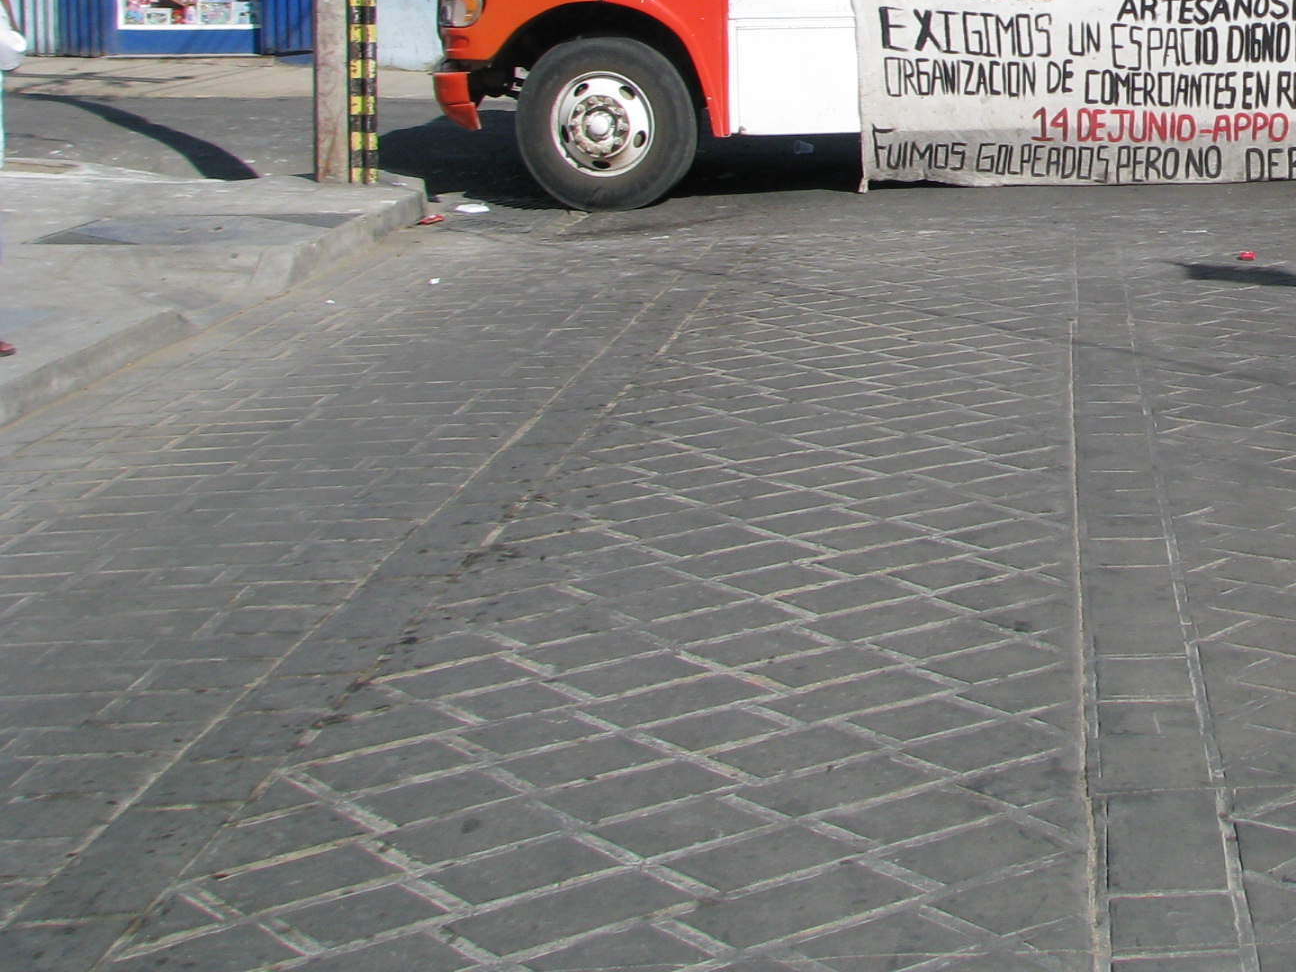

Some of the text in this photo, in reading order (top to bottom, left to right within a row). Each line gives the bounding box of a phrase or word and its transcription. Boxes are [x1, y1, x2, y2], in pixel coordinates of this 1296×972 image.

[879, 6, 1053, 58] EXIGIMOS
[1068, 21, 1100, 56] UN
[1111, 23, 1219, 71] ESPACIO
[1226, 21, 1290, 63] DIGNO
[884, 57, 1036, 98] ORGANIZACION
[1046, 59, 1074, 94] DE
[1085, 69, 1237, 110] COMERCIANTES
[1242, 69, 1270, 110] EN
[1031, 106, 1069, 142] 14
[1077, 107, 1106, 143] DE
[872, 123, 968, 171] FUIMOS
[976, 143, 1109, 183] GOLPEADOS
[1116, 145, 1180, 184] PERO
[1185, 145, 1222, 179] NO
